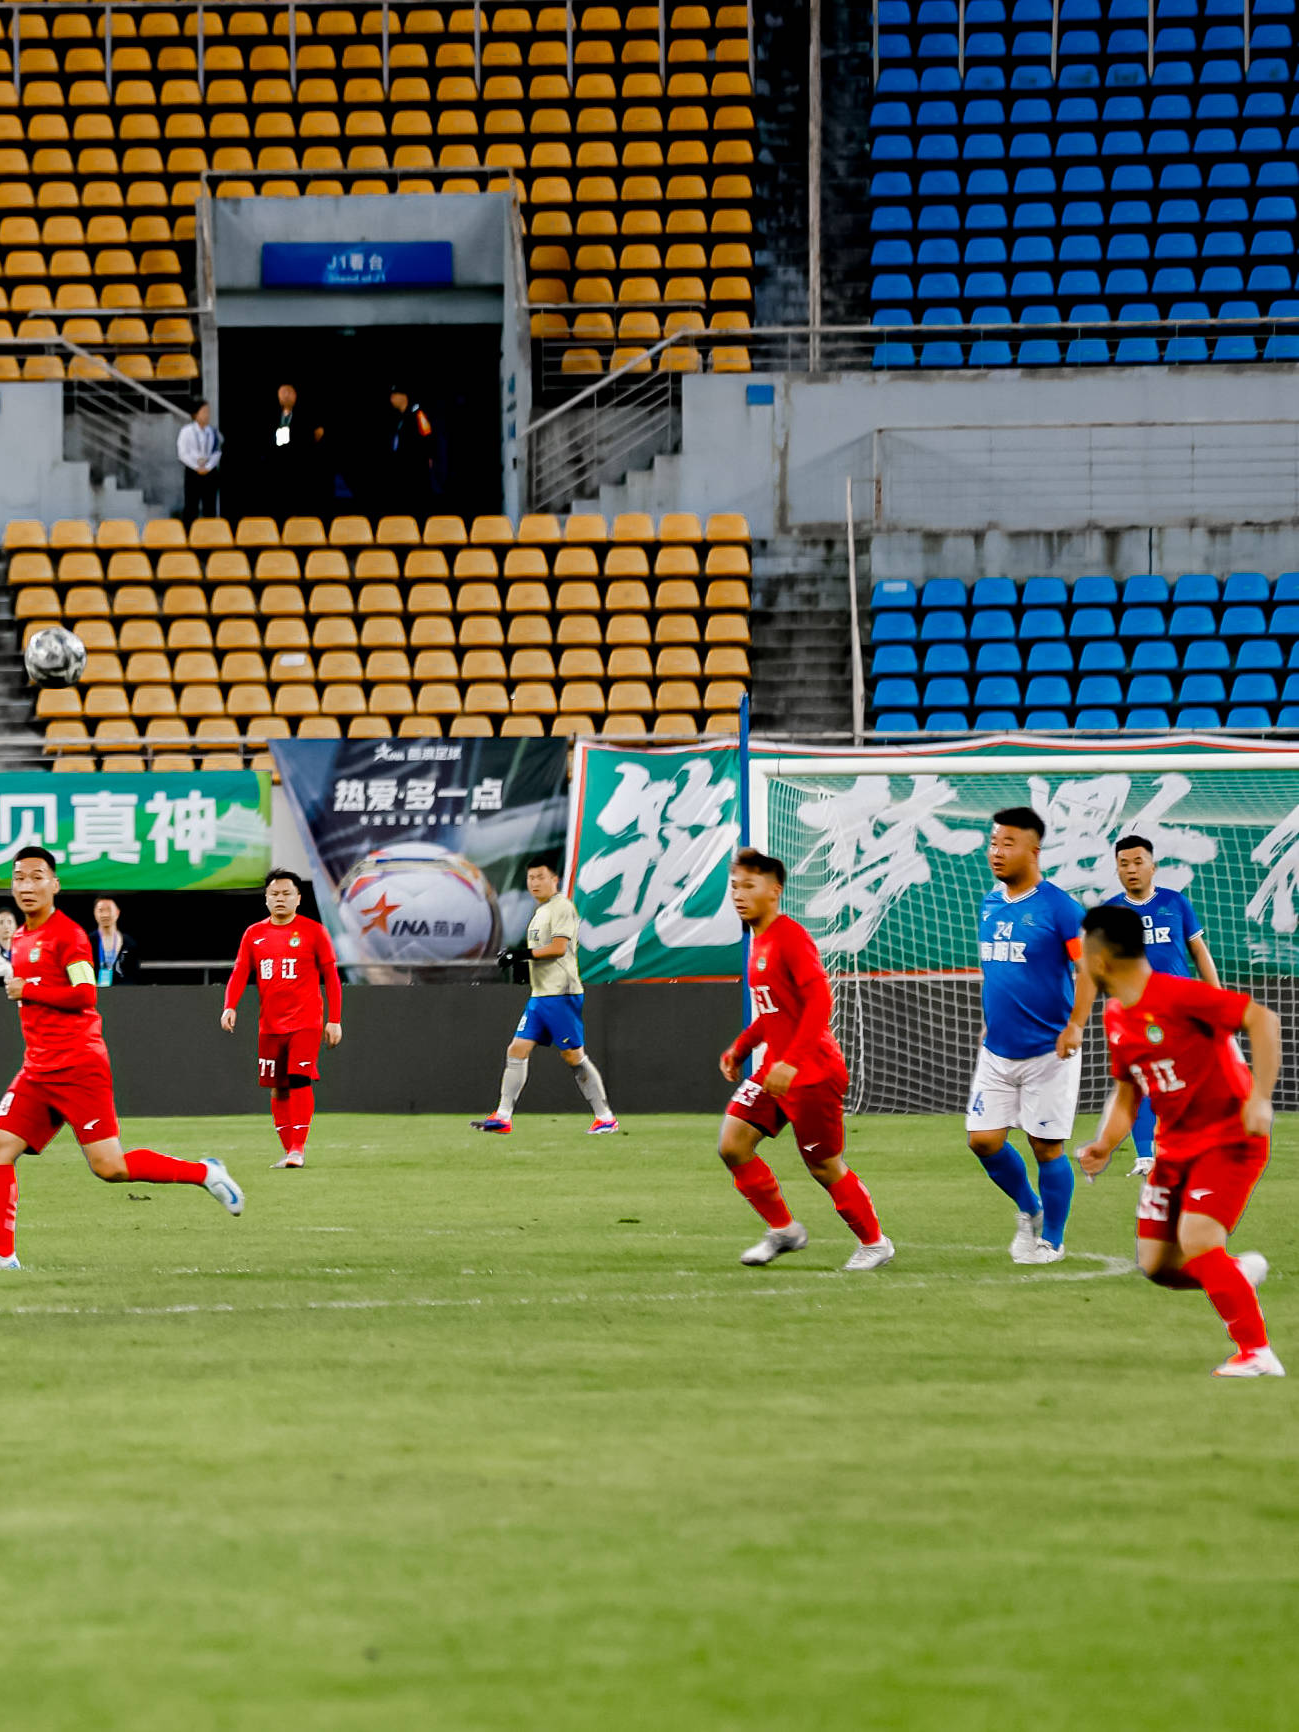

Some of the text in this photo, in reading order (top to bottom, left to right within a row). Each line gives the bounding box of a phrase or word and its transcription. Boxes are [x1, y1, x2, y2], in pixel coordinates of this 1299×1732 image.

[333, 777, 503, 812] 热爱·多一点
[993, 920, 1014, 940] 24
[258, 1058, 276, 1078] 77
